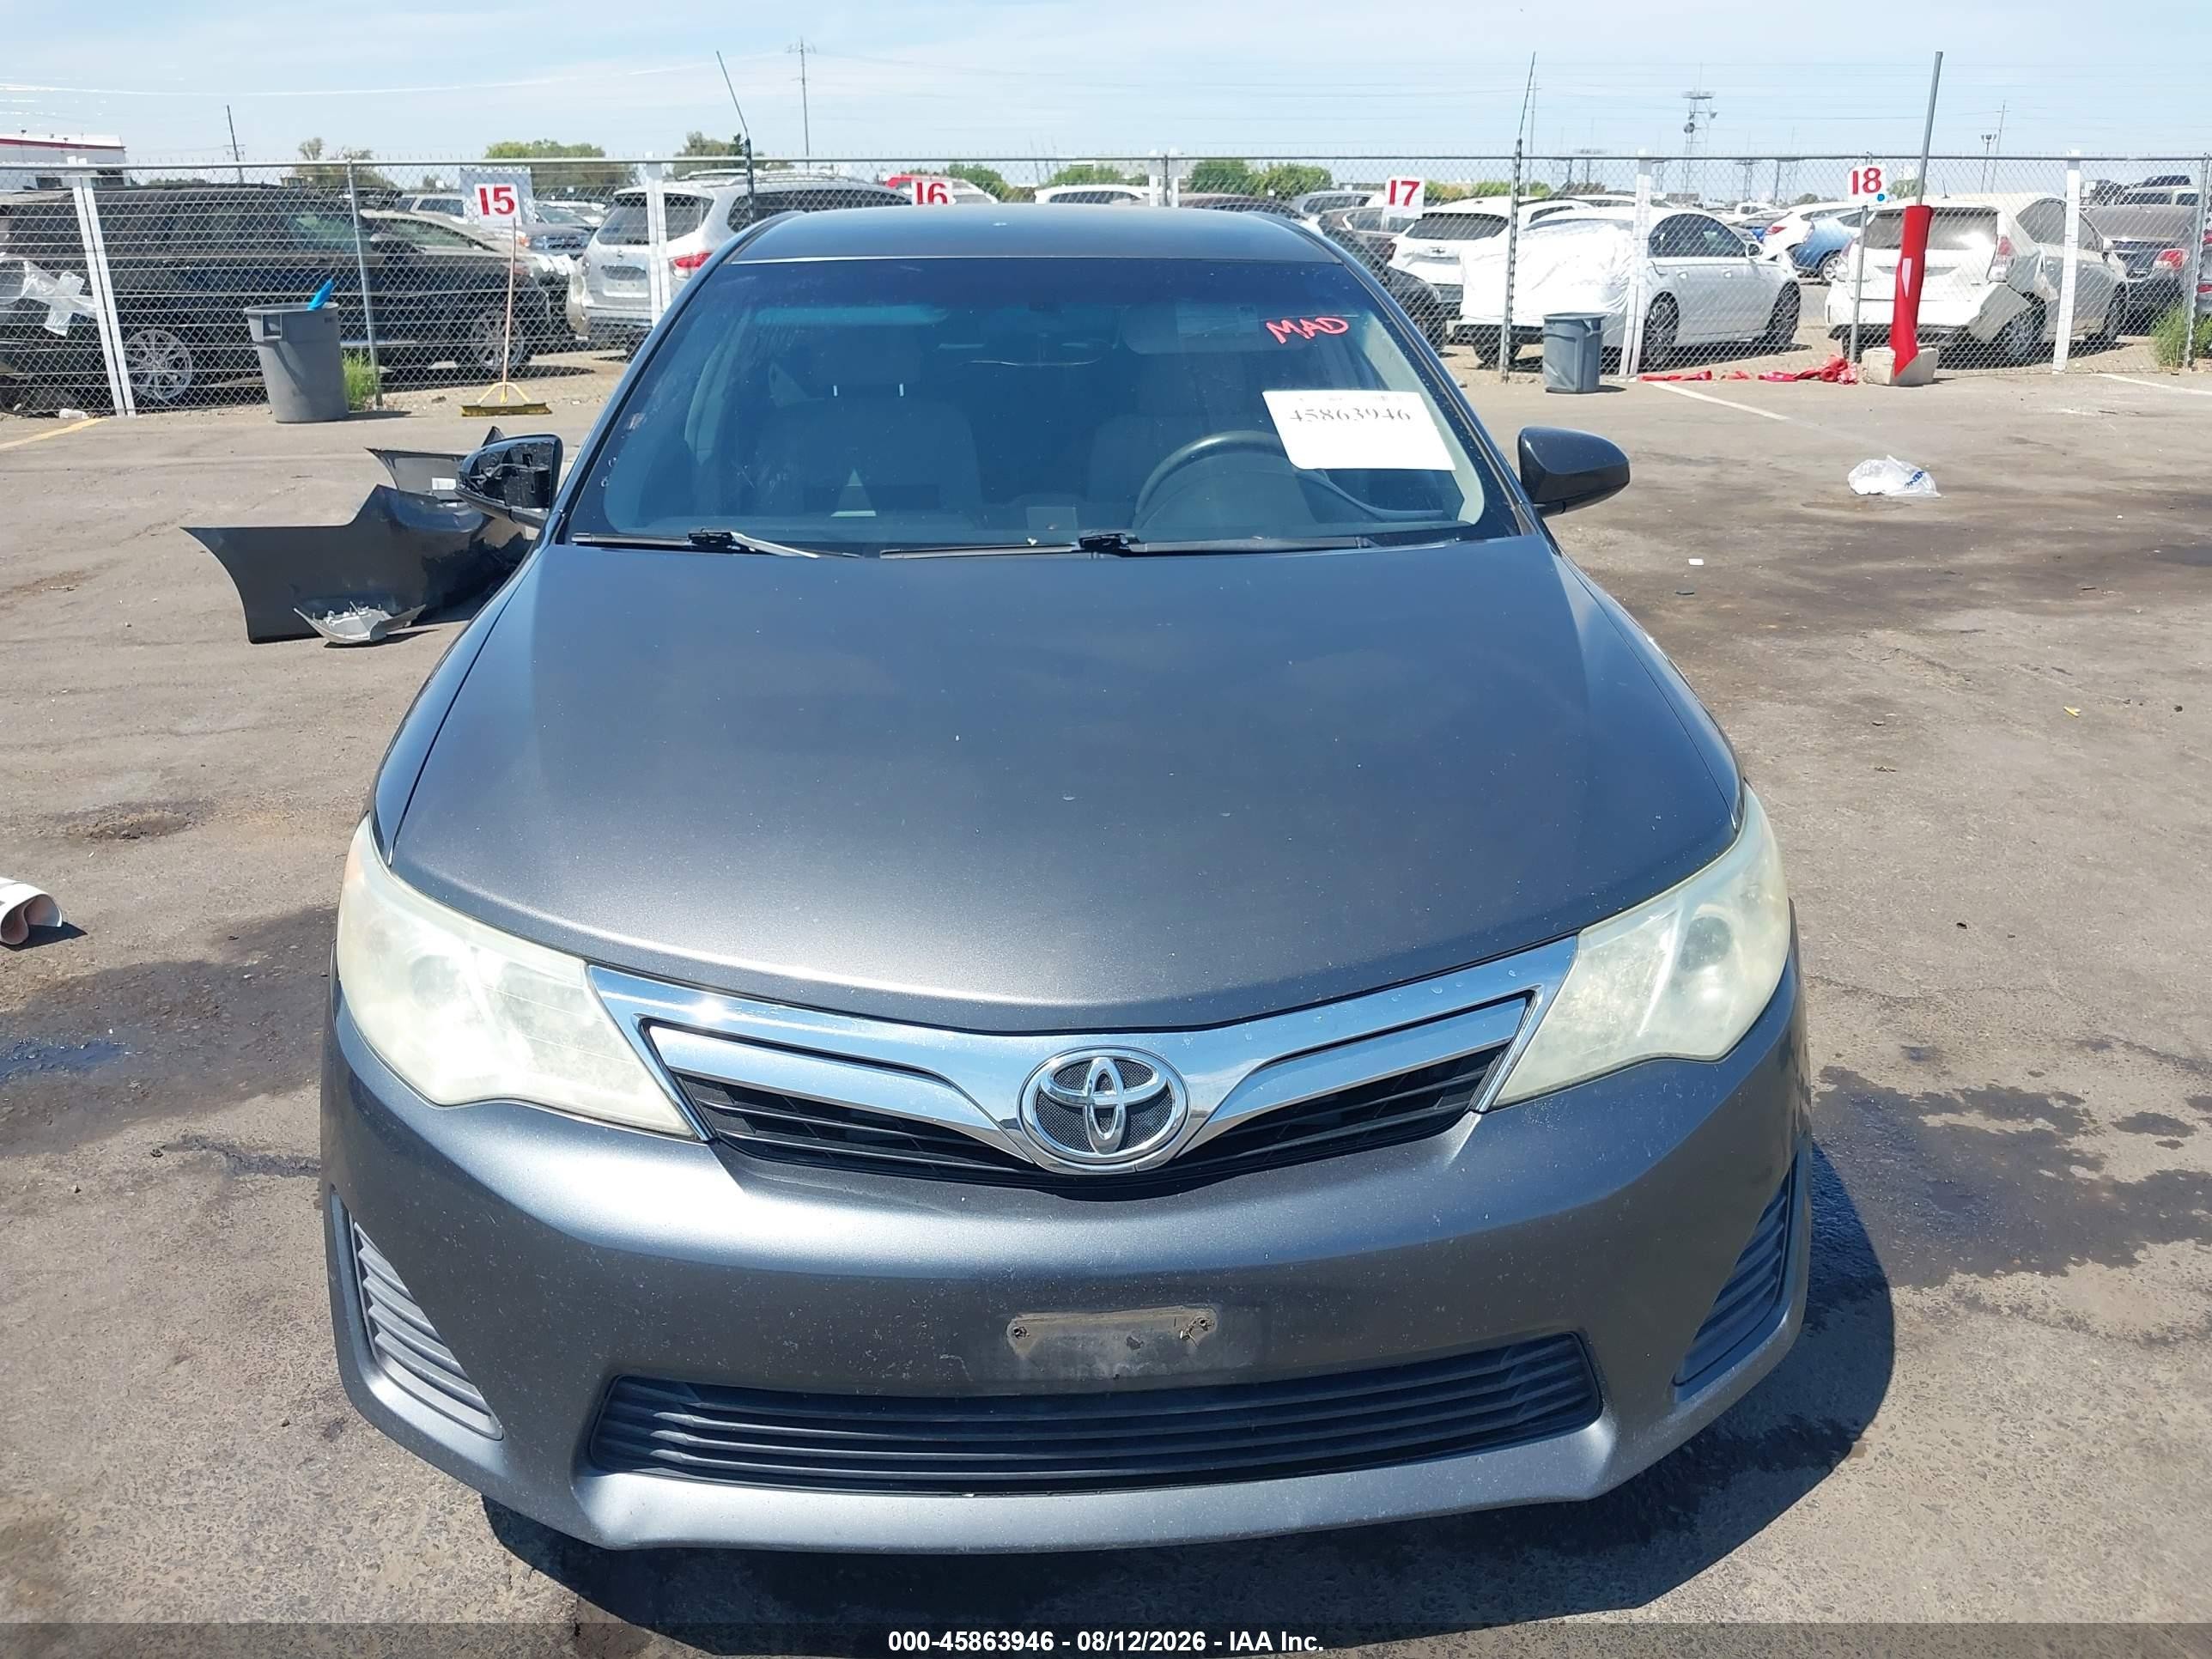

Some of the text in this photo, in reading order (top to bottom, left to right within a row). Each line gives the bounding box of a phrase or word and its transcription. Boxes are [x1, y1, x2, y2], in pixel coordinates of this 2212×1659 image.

[916, 182, 948, 205] 16
[1389, 179, 1420, 206] 17
[1852, 167, 1881, 195] 18
[479, 186, 515, 216] 15
[1266, 316, 1349, 344] MAD
